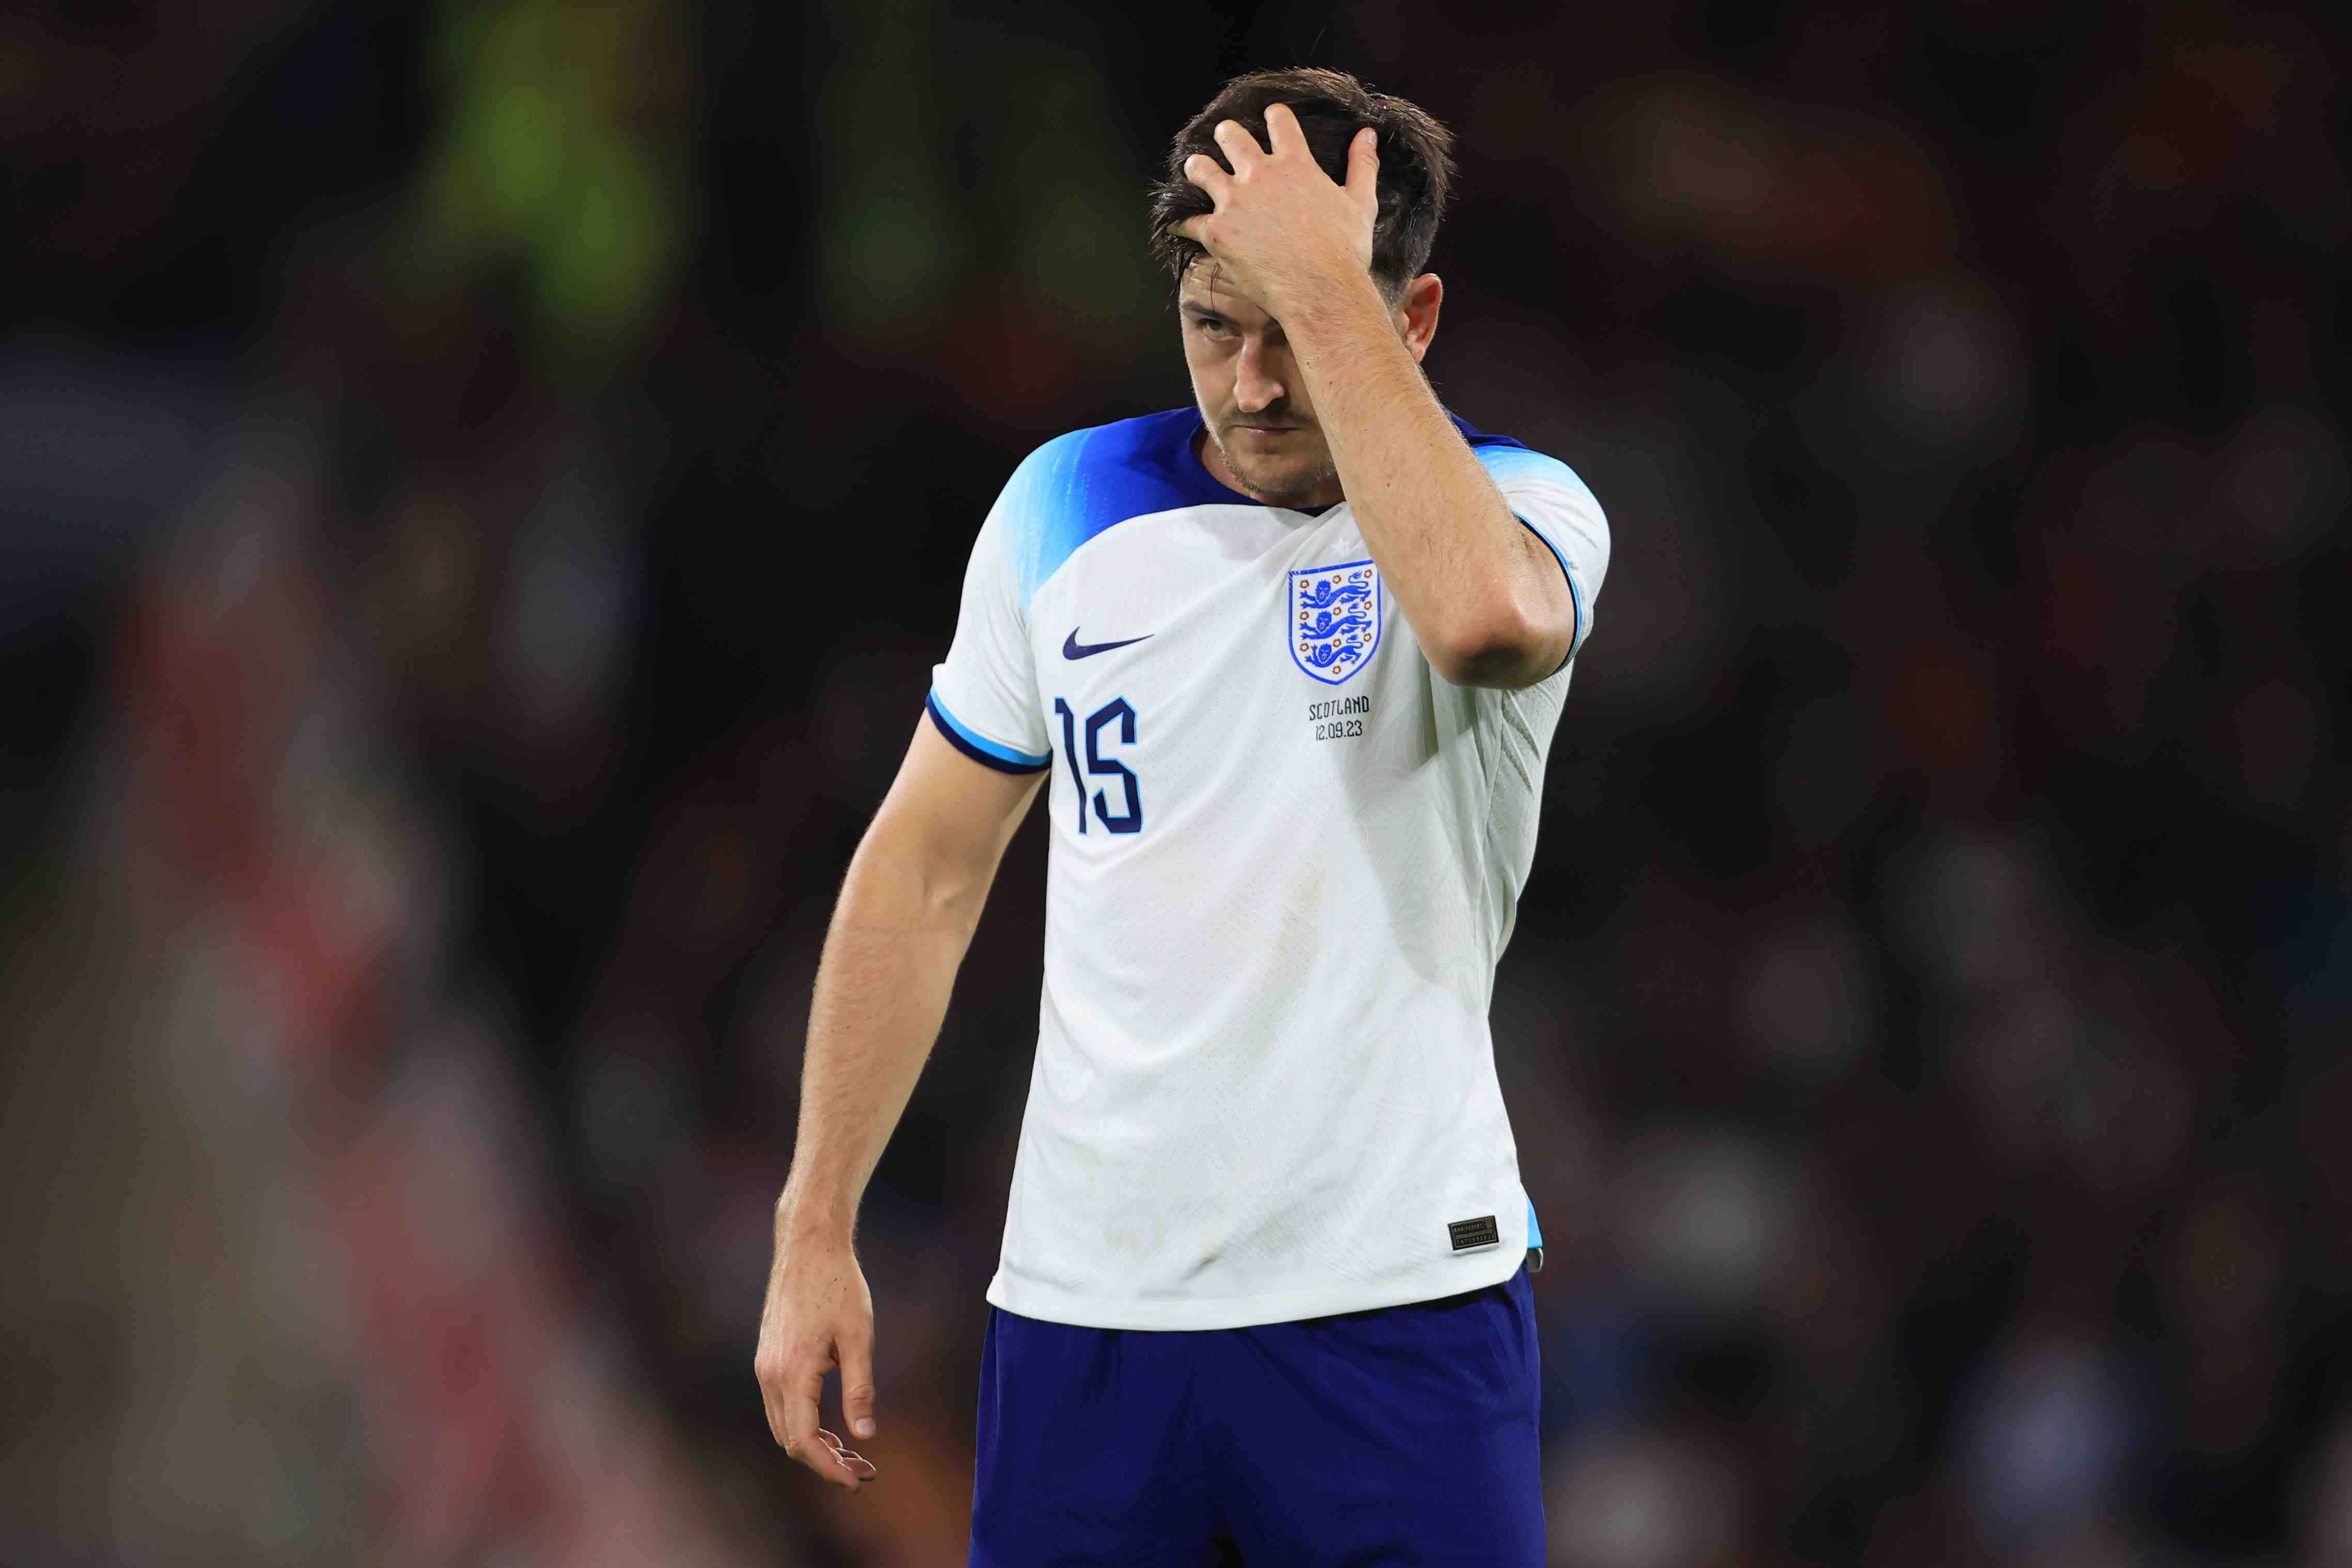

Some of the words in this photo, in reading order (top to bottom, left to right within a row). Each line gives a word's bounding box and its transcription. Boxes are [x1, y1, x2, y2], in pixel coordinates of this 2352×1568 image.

[1309, 696, 1370, 720] SCOTLAND
[1315, 719, 1363, 741] 12.09.23
[1054, 696, 1143, 835] 15
